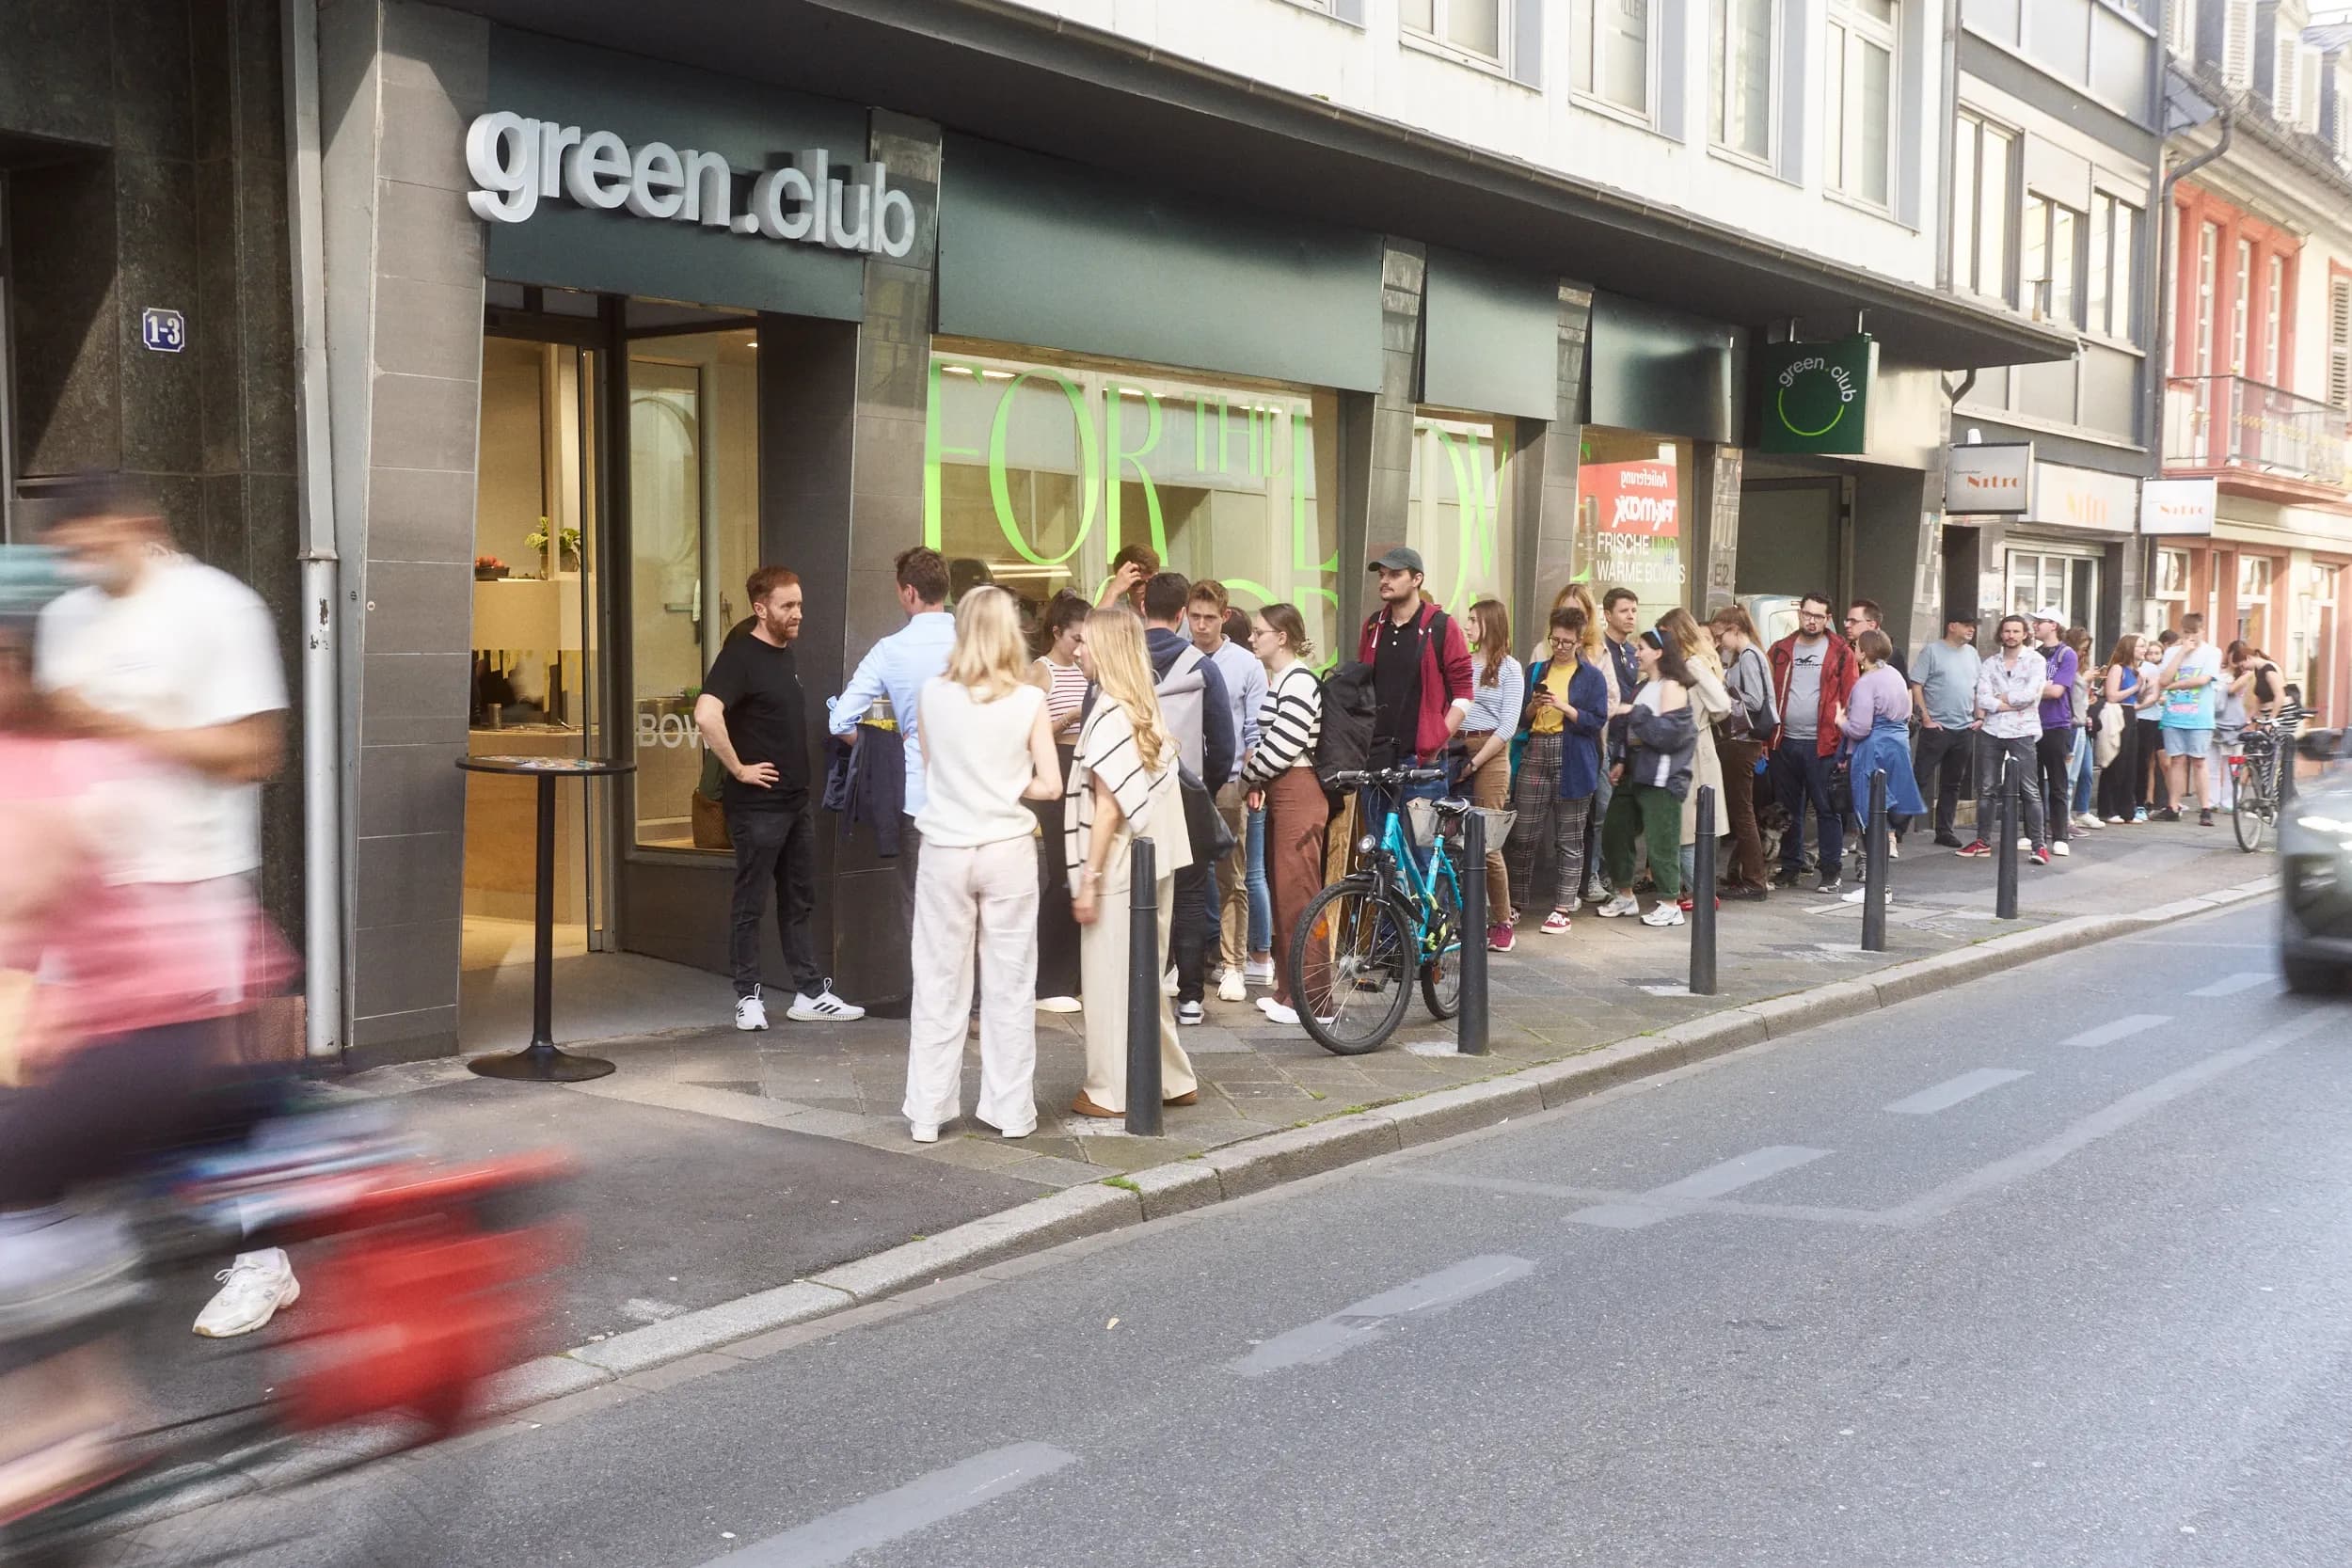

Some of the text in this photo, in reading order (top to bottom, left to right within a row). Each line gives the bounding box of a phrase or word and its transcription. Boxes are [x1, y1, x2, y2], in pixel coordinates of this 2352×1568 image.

[466, 111, 915, 257] green.club
[148, 315, 180, 345] 1-3
[924, 357, 1168, 567] FOR
[1597, 531, 1650, 556] FRISCHE
